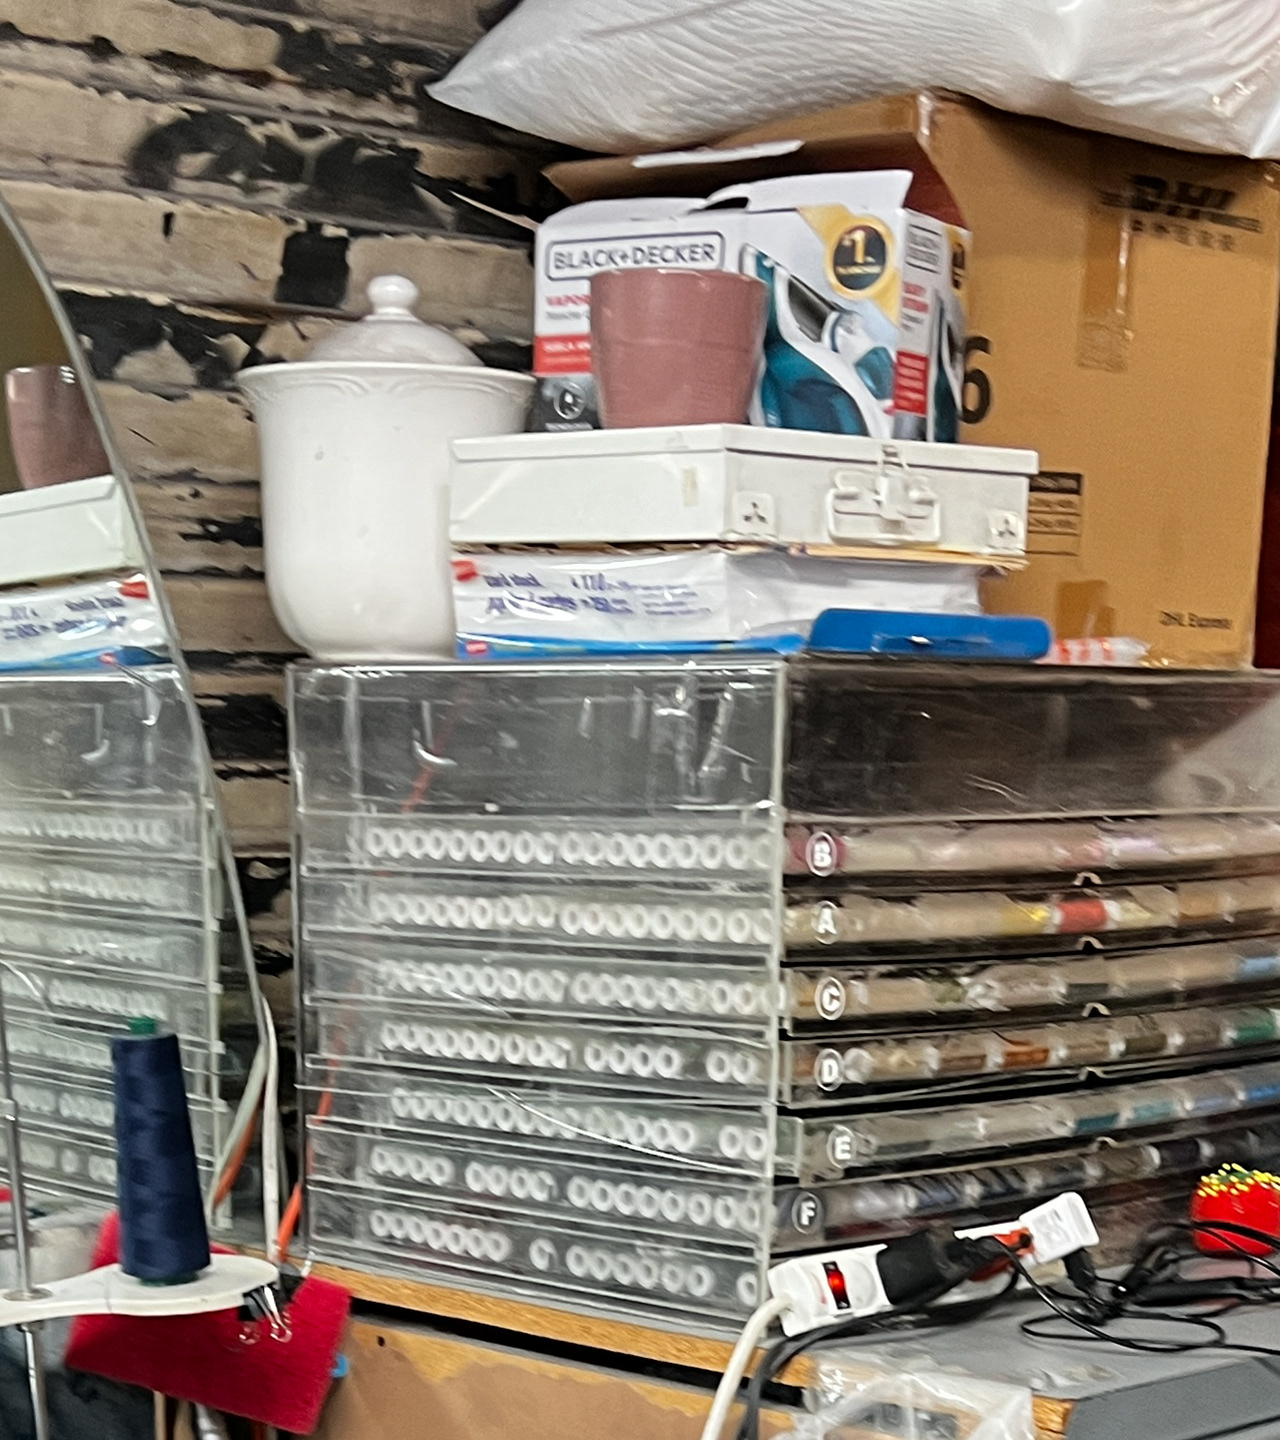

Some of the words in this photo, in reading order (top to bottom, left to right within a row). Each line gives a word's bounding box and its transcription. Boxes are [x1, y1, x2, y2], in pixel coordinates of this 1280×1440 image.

[553, 243, 716, 270] BLACK+DECKER
[961, 336, 991, 424] 6
[813, 840, 831, 867] B
[818, 907, 837, 934] A
[822, 985, 840, 1011] C
[822, 1058, 838, 1083] D
[835, 1135, 851, 1160] E
[801, 1201, 816, 1226] F
